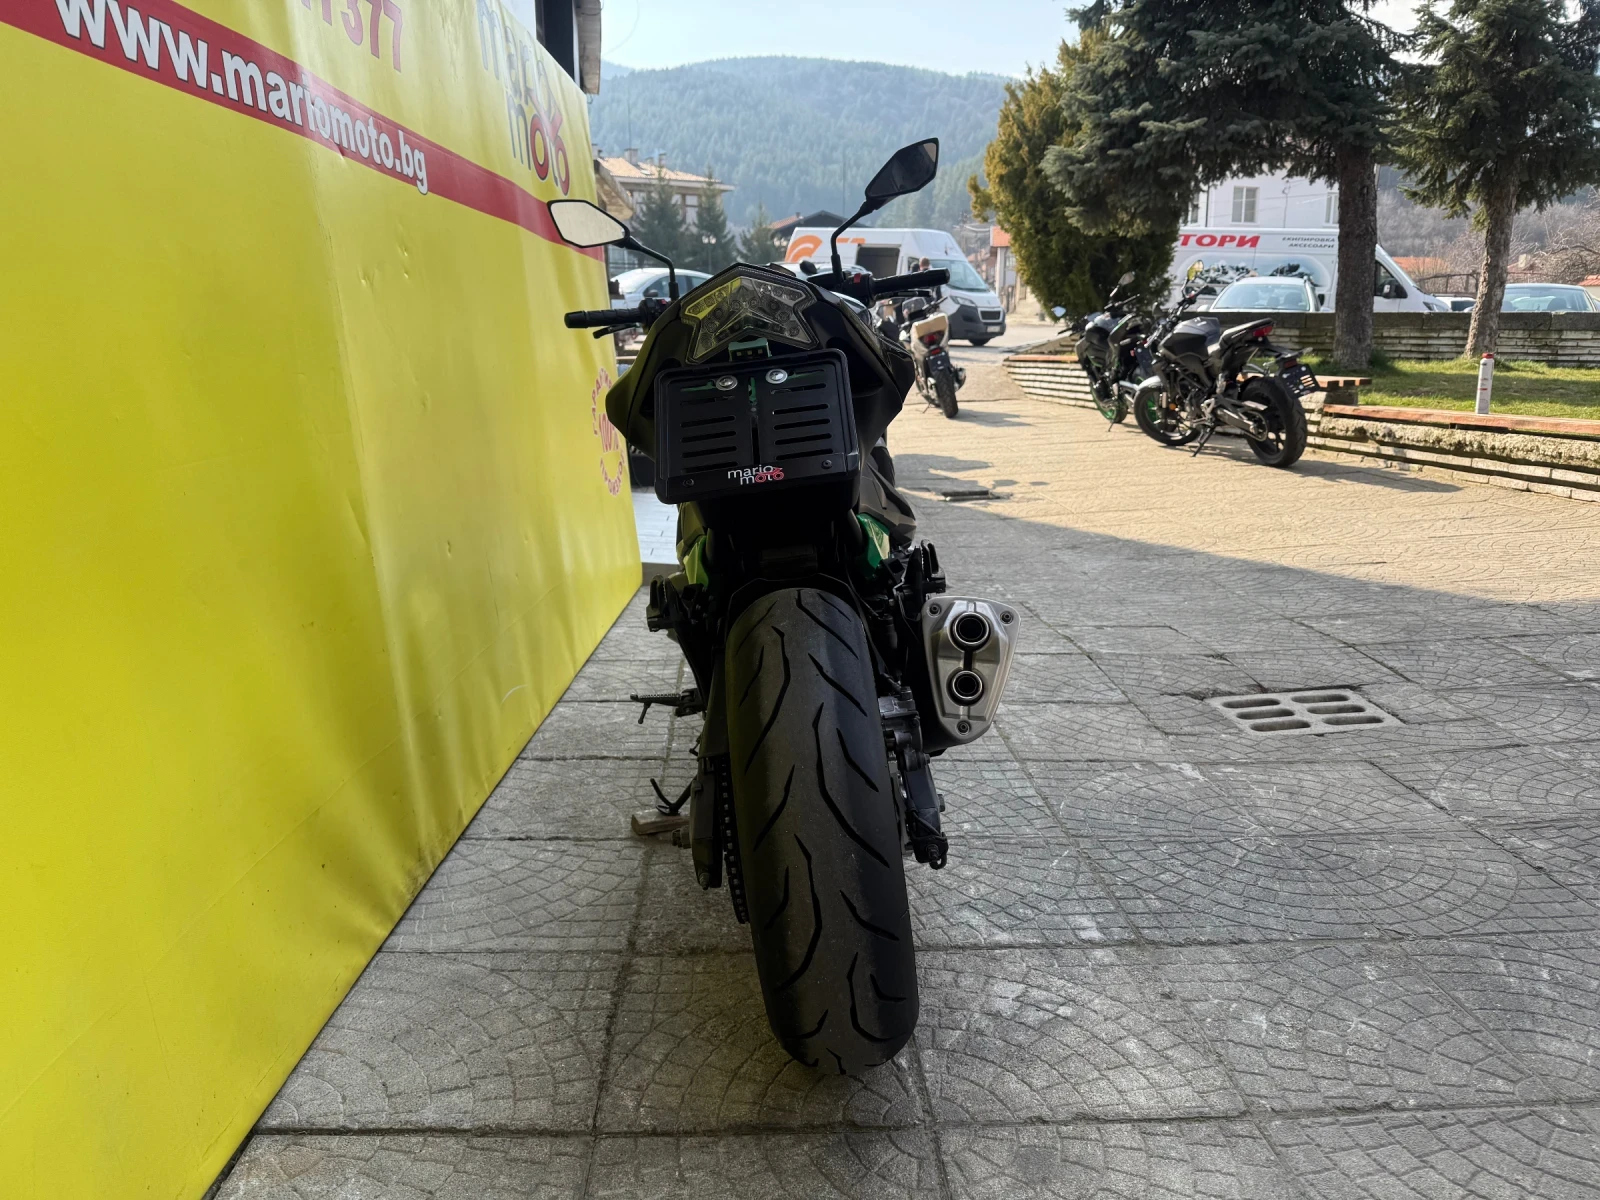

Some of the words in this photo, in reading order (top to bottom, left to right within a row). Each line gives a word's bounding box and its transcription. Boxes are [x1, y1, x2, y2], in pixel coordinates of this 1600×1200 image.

[55, 0, 428, 195] www.mariomoto.bg
[727, 464, 773, 479] mario
[740, 471, 785, 485] moto
